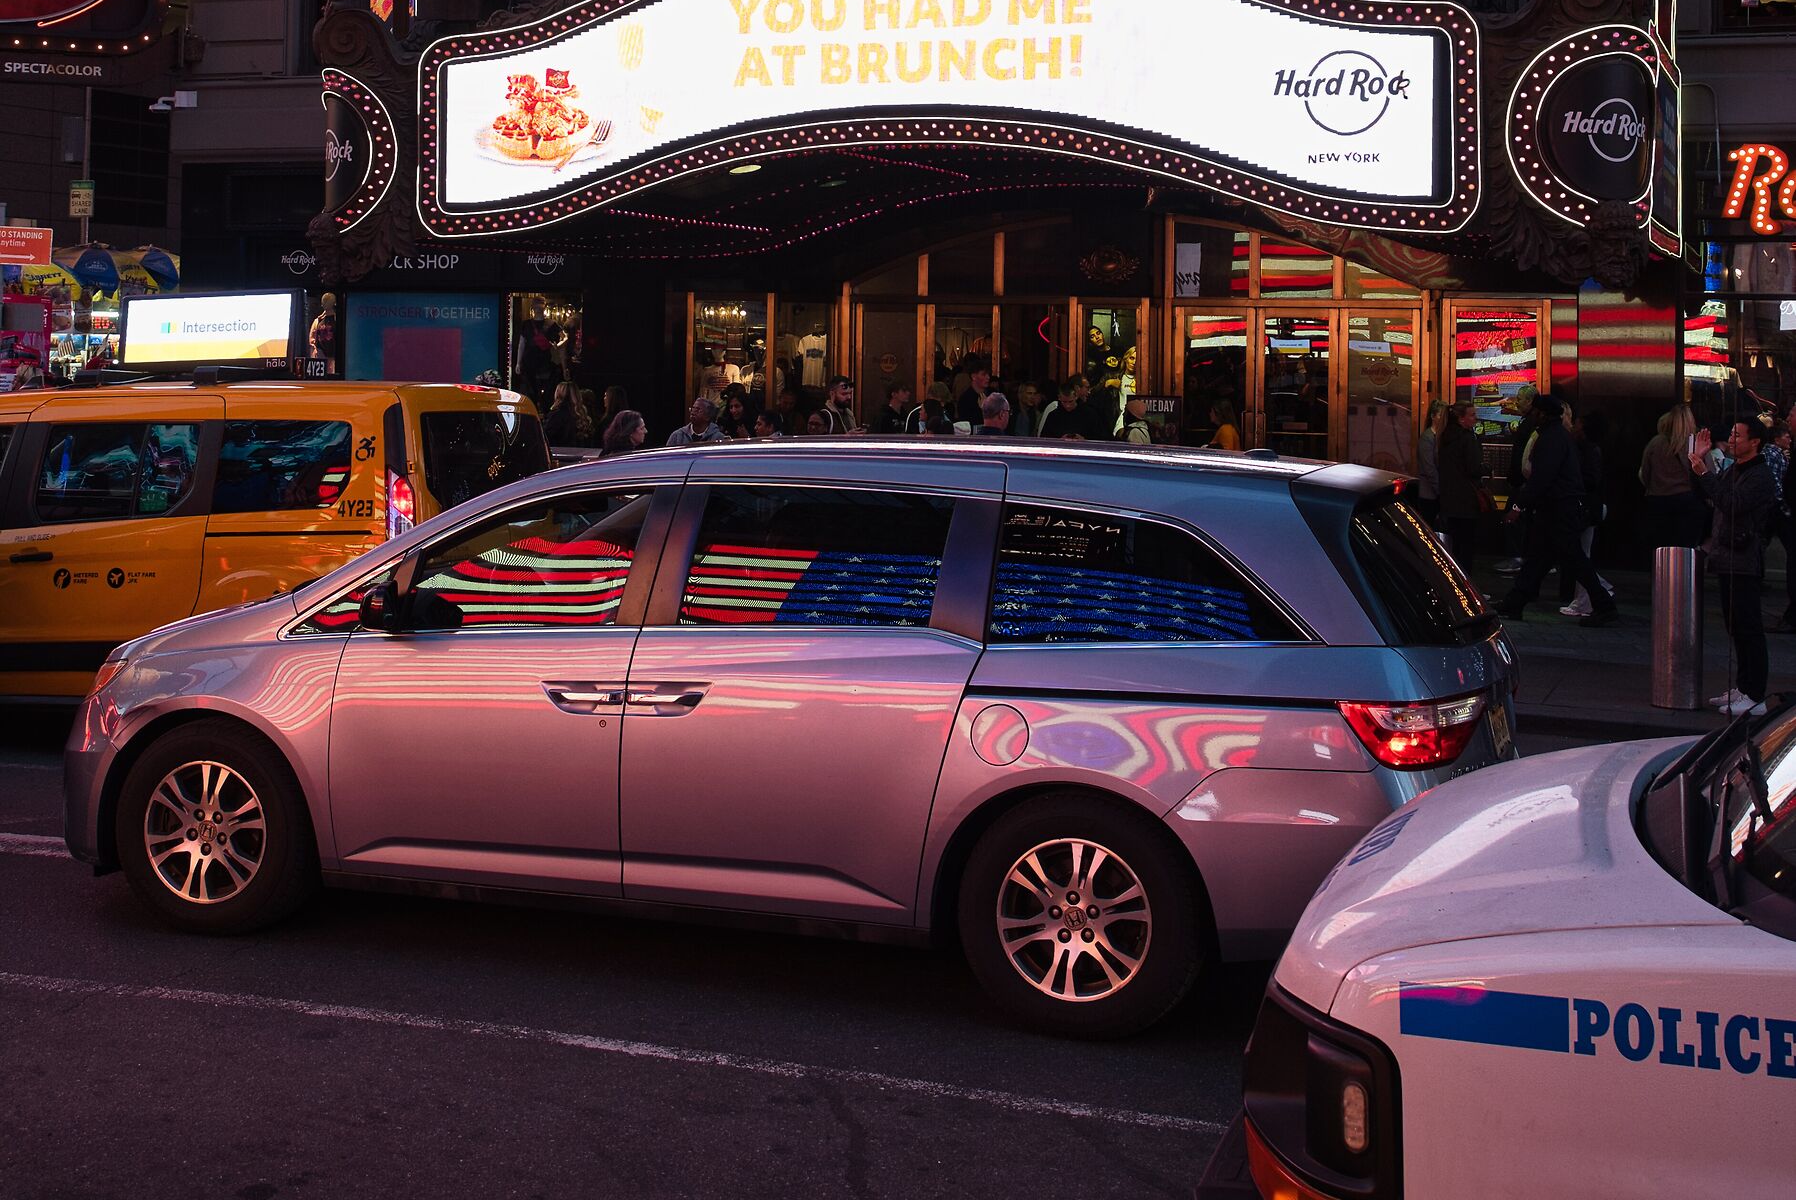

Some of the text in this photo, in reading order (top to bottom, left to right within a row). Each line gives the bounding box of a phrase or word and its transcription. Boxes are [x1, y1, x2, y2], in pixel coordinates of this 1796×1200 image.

[733, 34, 1084, 87] AT BRUNCH!
[3, 62, 103, 77] SPECTACOLOR
[1273, 68, 1410, 102] Hard Rock
[1562, 110, 1646, 142] Hard Rock
[1308, 152, 1381, 164] NEW YORK
[8, 230, 43, 240] STANDING
[0, 239, 26, 248] nytime
[281, 255, 299, 265] Hard
[417, 254, 460, 269] SHOP
[358, 305, 490, 320] STRONGER TOGETHER
[182, 320, 257, 333] Intersection
[306, 361, 325, 377] 4Y23
[337, 499, 374, 518] 4Y23
[1573, 998, 1796, 1080] POLICE
